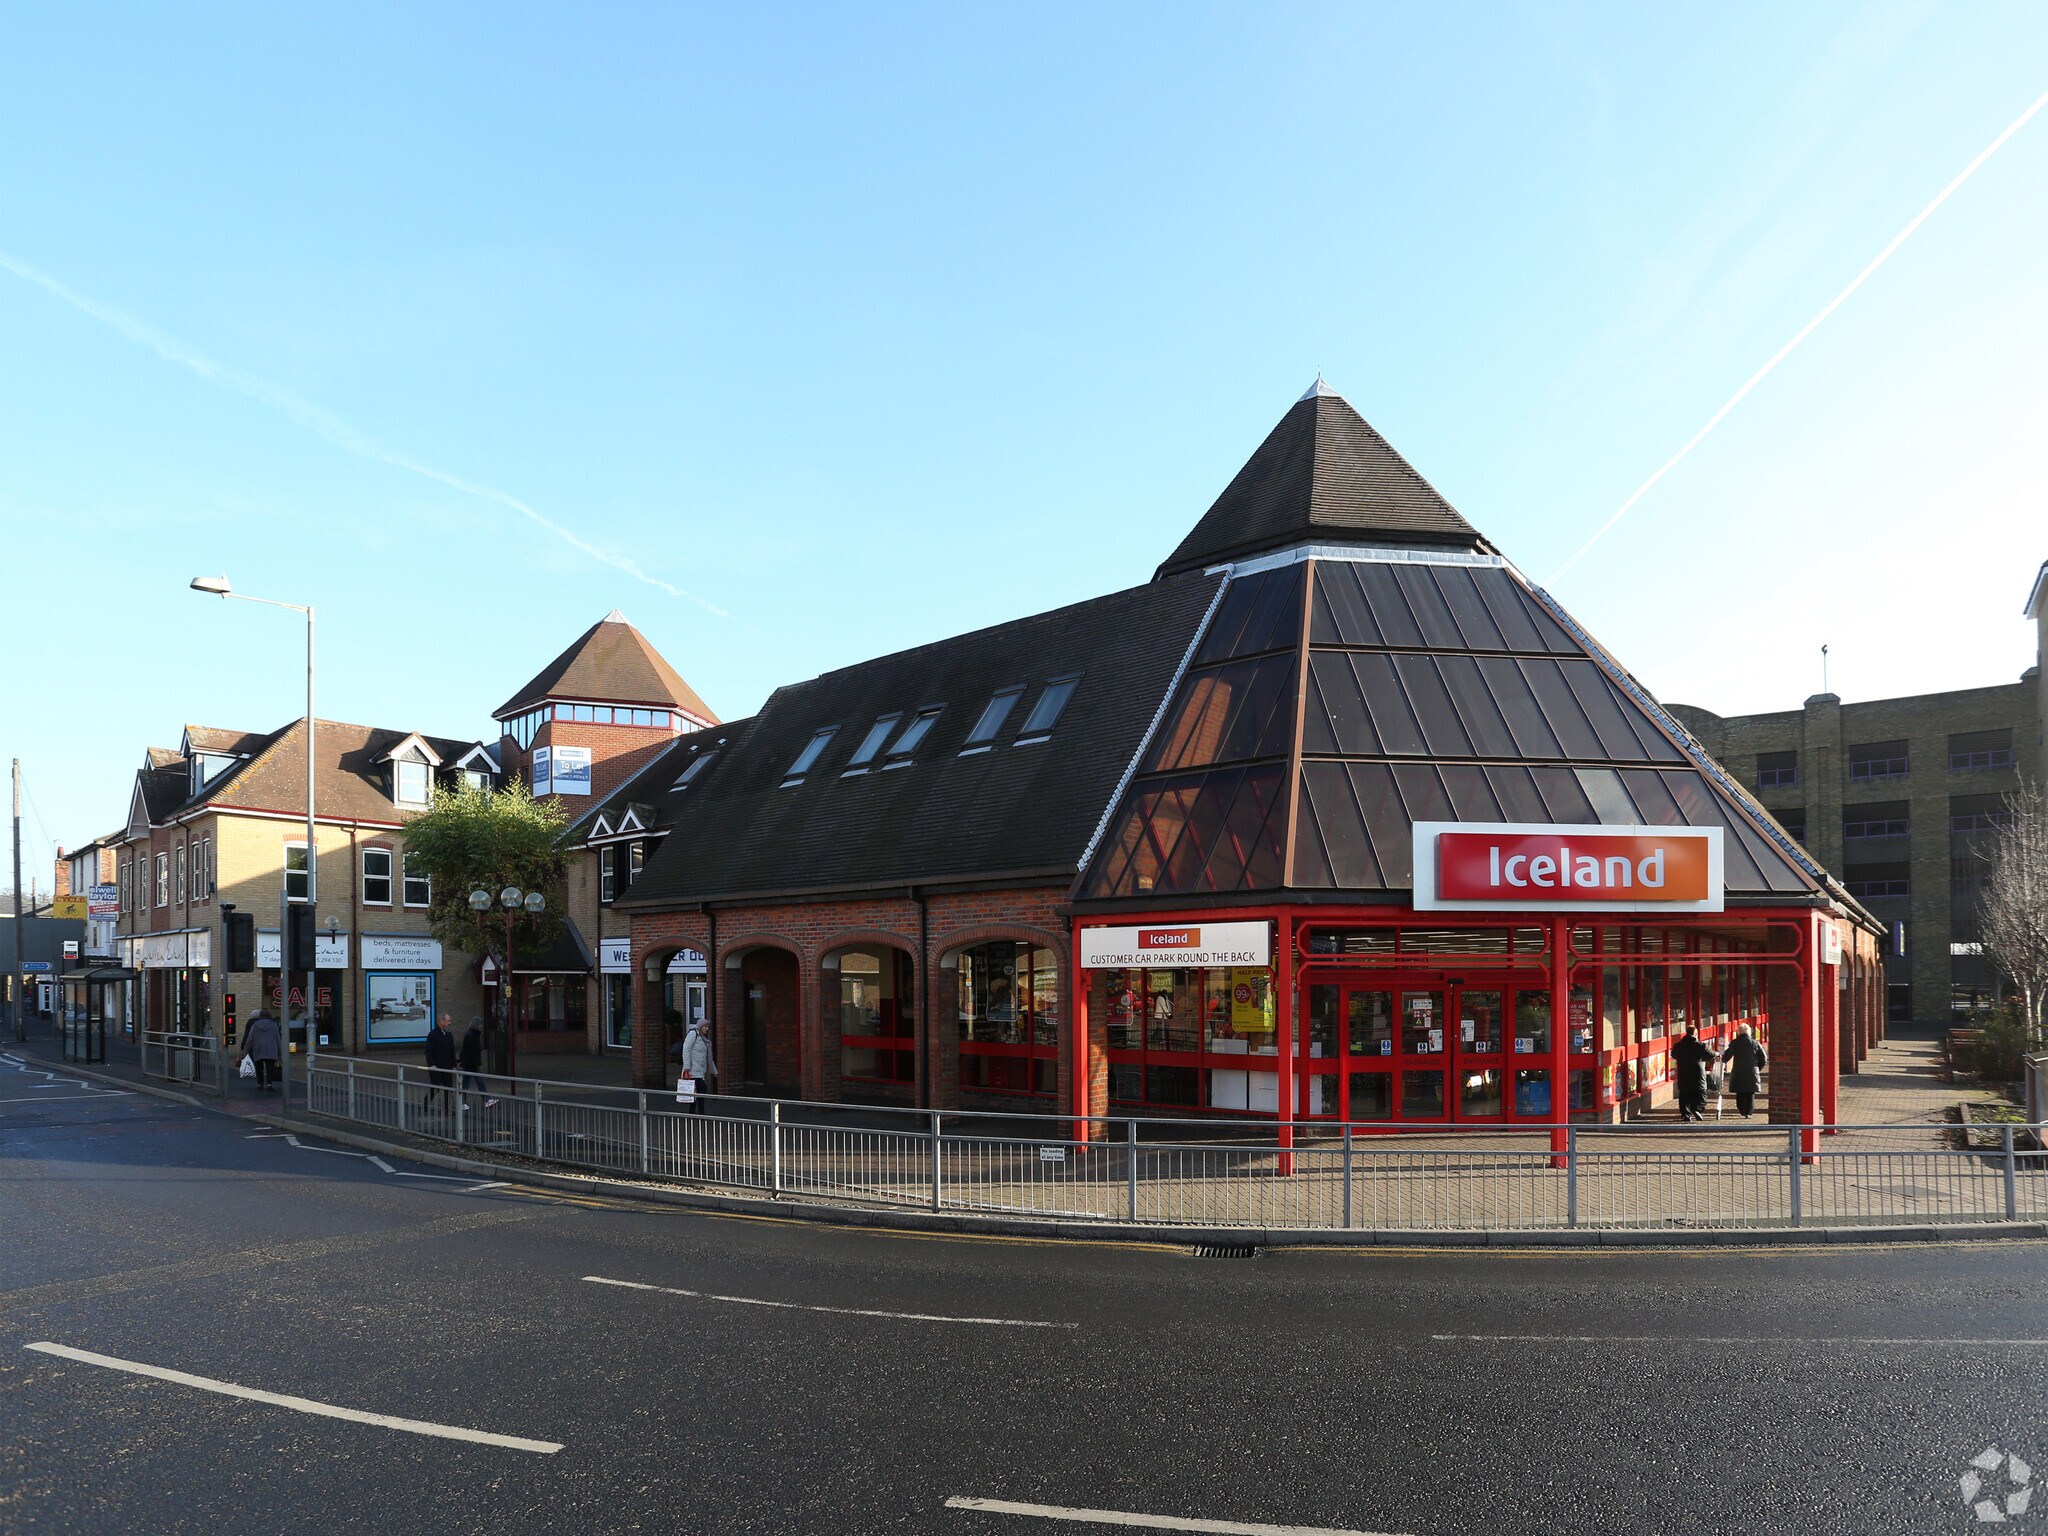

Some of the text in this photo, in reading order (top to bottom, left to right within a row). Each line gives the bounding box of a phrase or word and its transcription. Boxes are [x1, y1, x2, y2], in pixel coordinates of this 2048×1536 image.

[560, 760, 584, 770] To Let
[1489, 846, 1665, 888] Iceland
[90, 892, 117, 901] taylor
[373, 939, 431, 948] beds, mattresses
[1150, 933, 1188, 944] Iceland
[373, 956, 405, 964] delivered
[415, 957, 431, 965] days
[1090, 951, 1255, 964] CUSTOMER CAR PARK ROUND THE BACK
